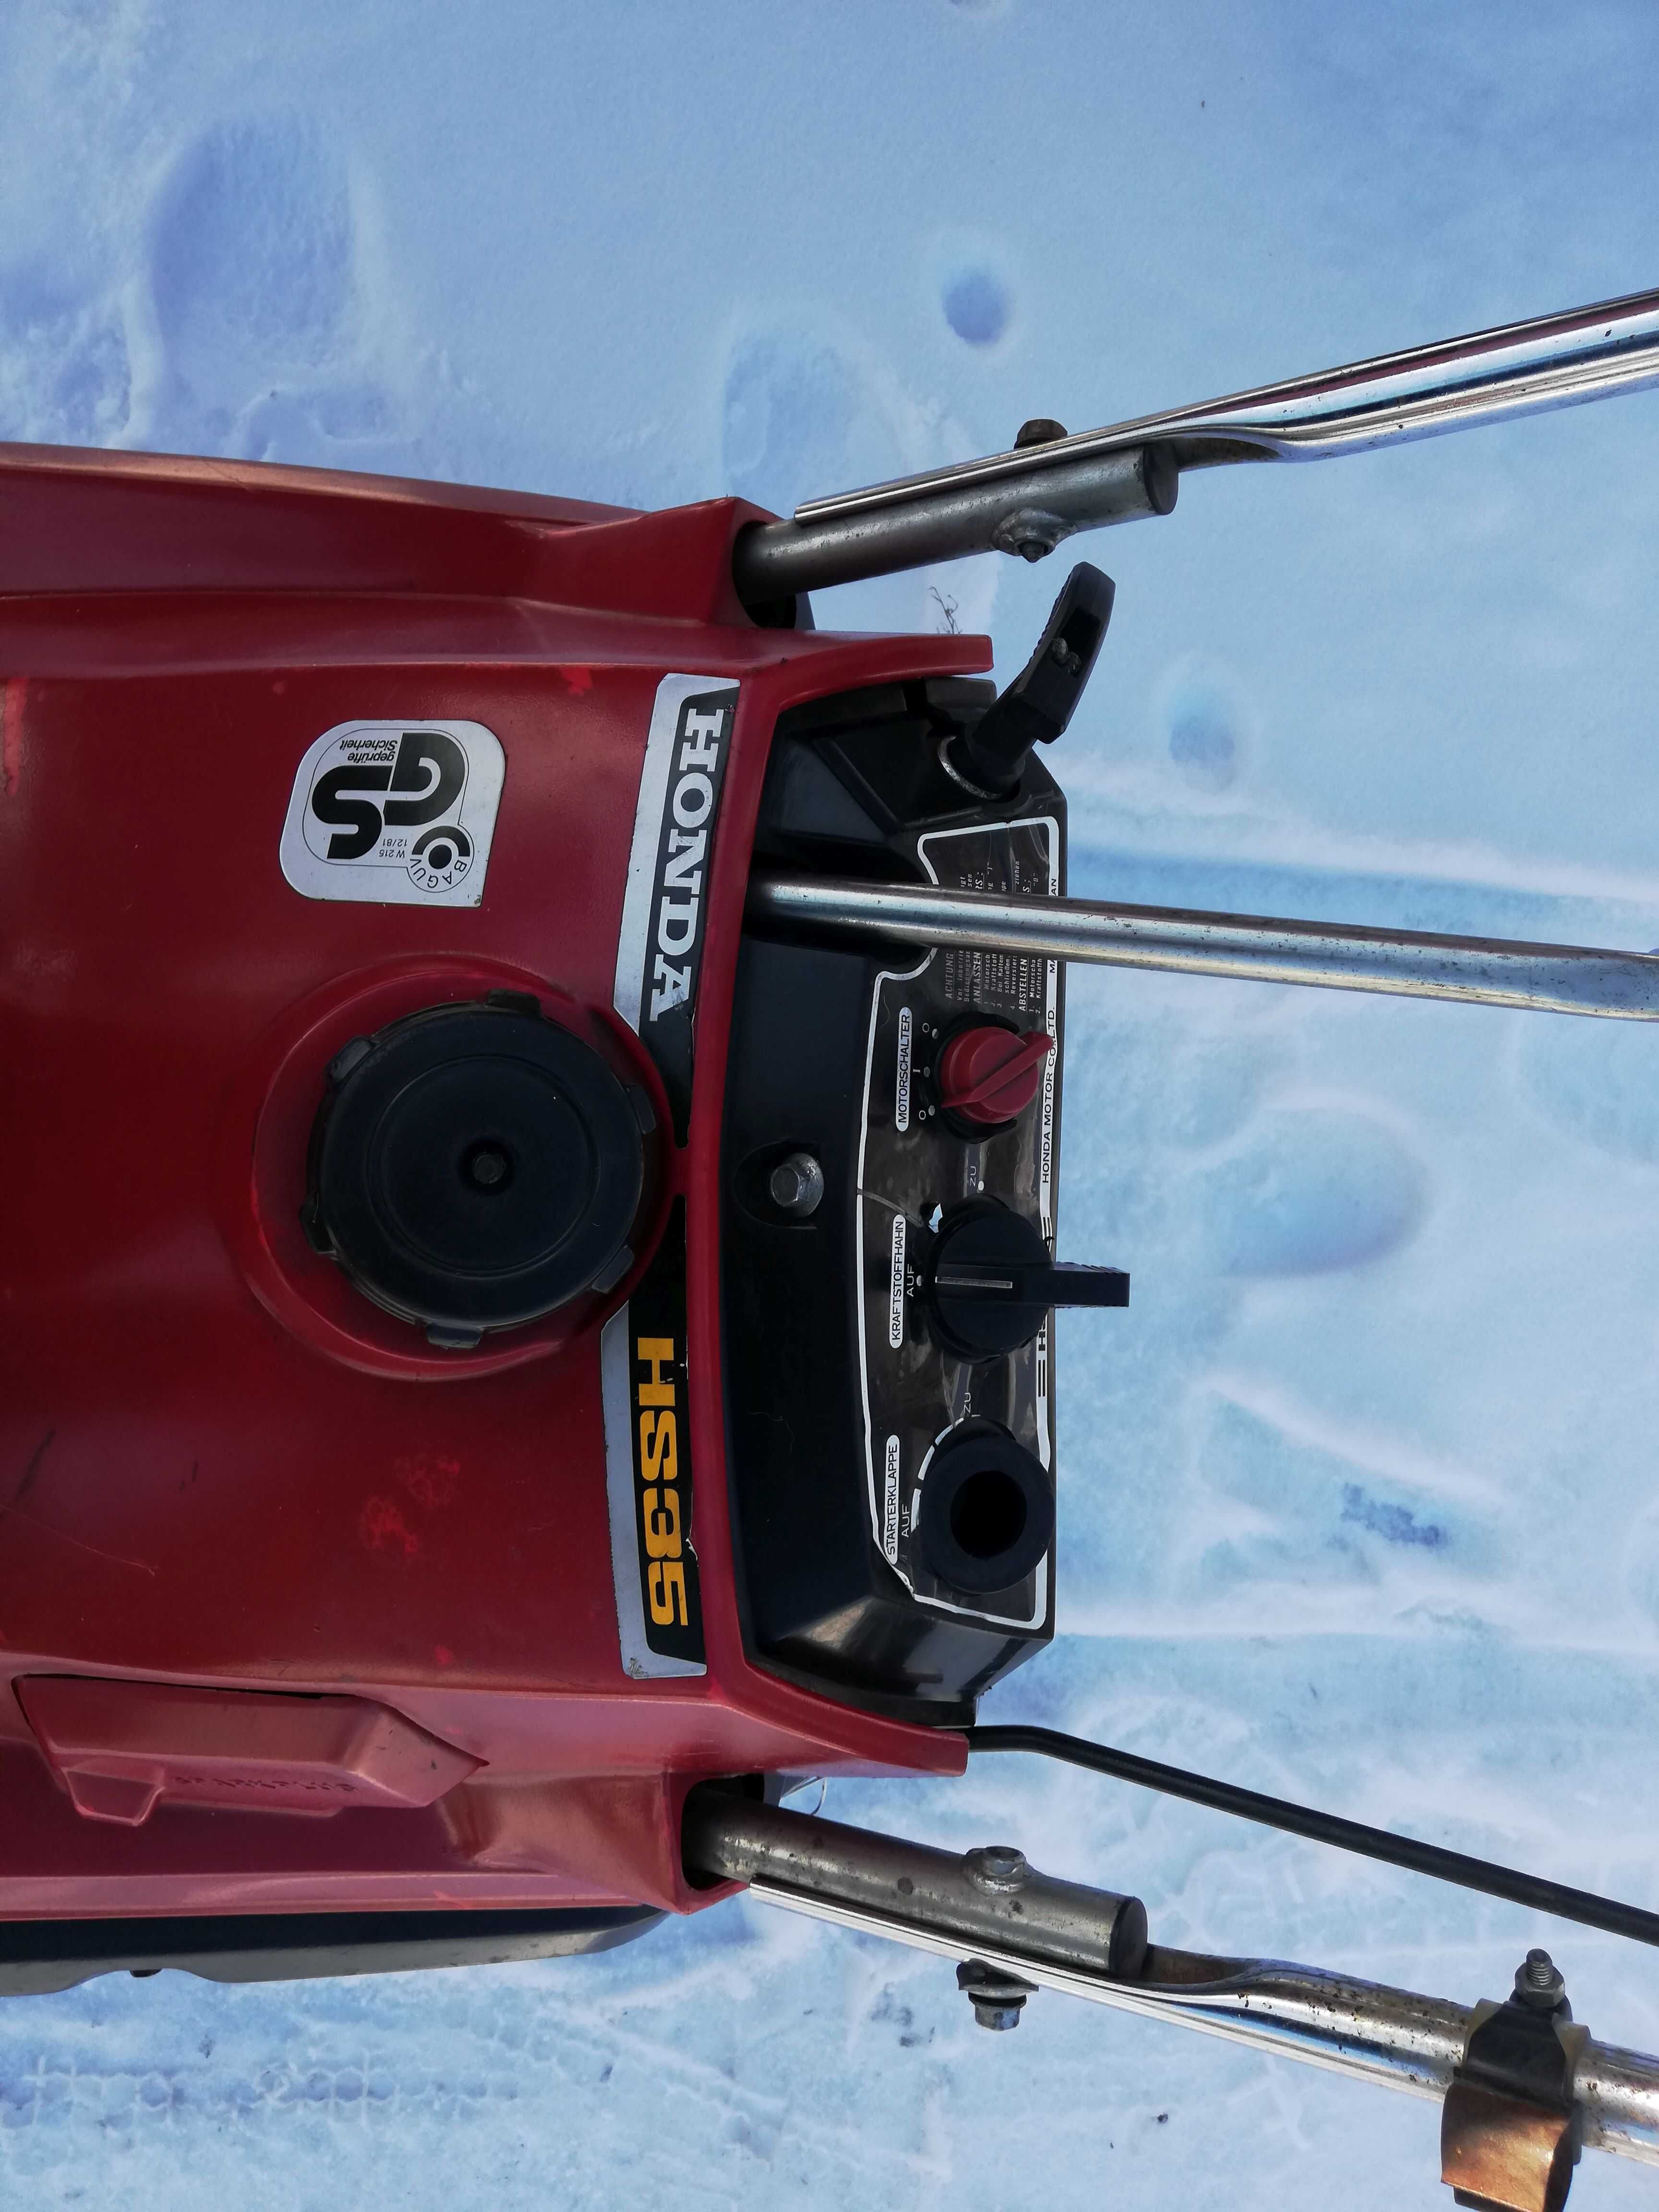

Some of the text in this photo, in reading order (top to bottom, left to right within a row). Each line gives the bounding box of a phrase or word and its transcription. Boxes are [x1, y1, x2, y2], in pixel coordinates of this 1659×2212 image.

[340, 739, 397, 751] Sicherheit
[347, 751, 396, 763] geprüfte
[312, 733, 465, 860] GS
[383, 838, 408, 847] 12/81
[397, 850, 405, 858] W
[649, 709, 724, 1022] HONDA
[409, 858, 467, 888] BAGUV
[945, 953, 954, 999] ACHTUNG
[973, 952, 981, 1003] ANLASSEN
[1018, 958, 1027, 1011] ABSTELLEN
[898, 1014, 910, 1123] MOTORSCHALTER
[1044, 1071, 1053, 1126] MOTOR
[969, 1166, 976, 1187] ZU
[1042, 1131, 1051, 1184] HONDA
[891, 1221, 903, 1341] KRAFTSTOFFHAHN
[906, 1263, 914, 1298] AUF
[963, 1392, 972, 1414] ZU
[637, 1337, 689, 1626] HS35
[886, 1444, 897, 1555] STARTERKLAPPE
[901, 1503, 910, 1538] AUF
